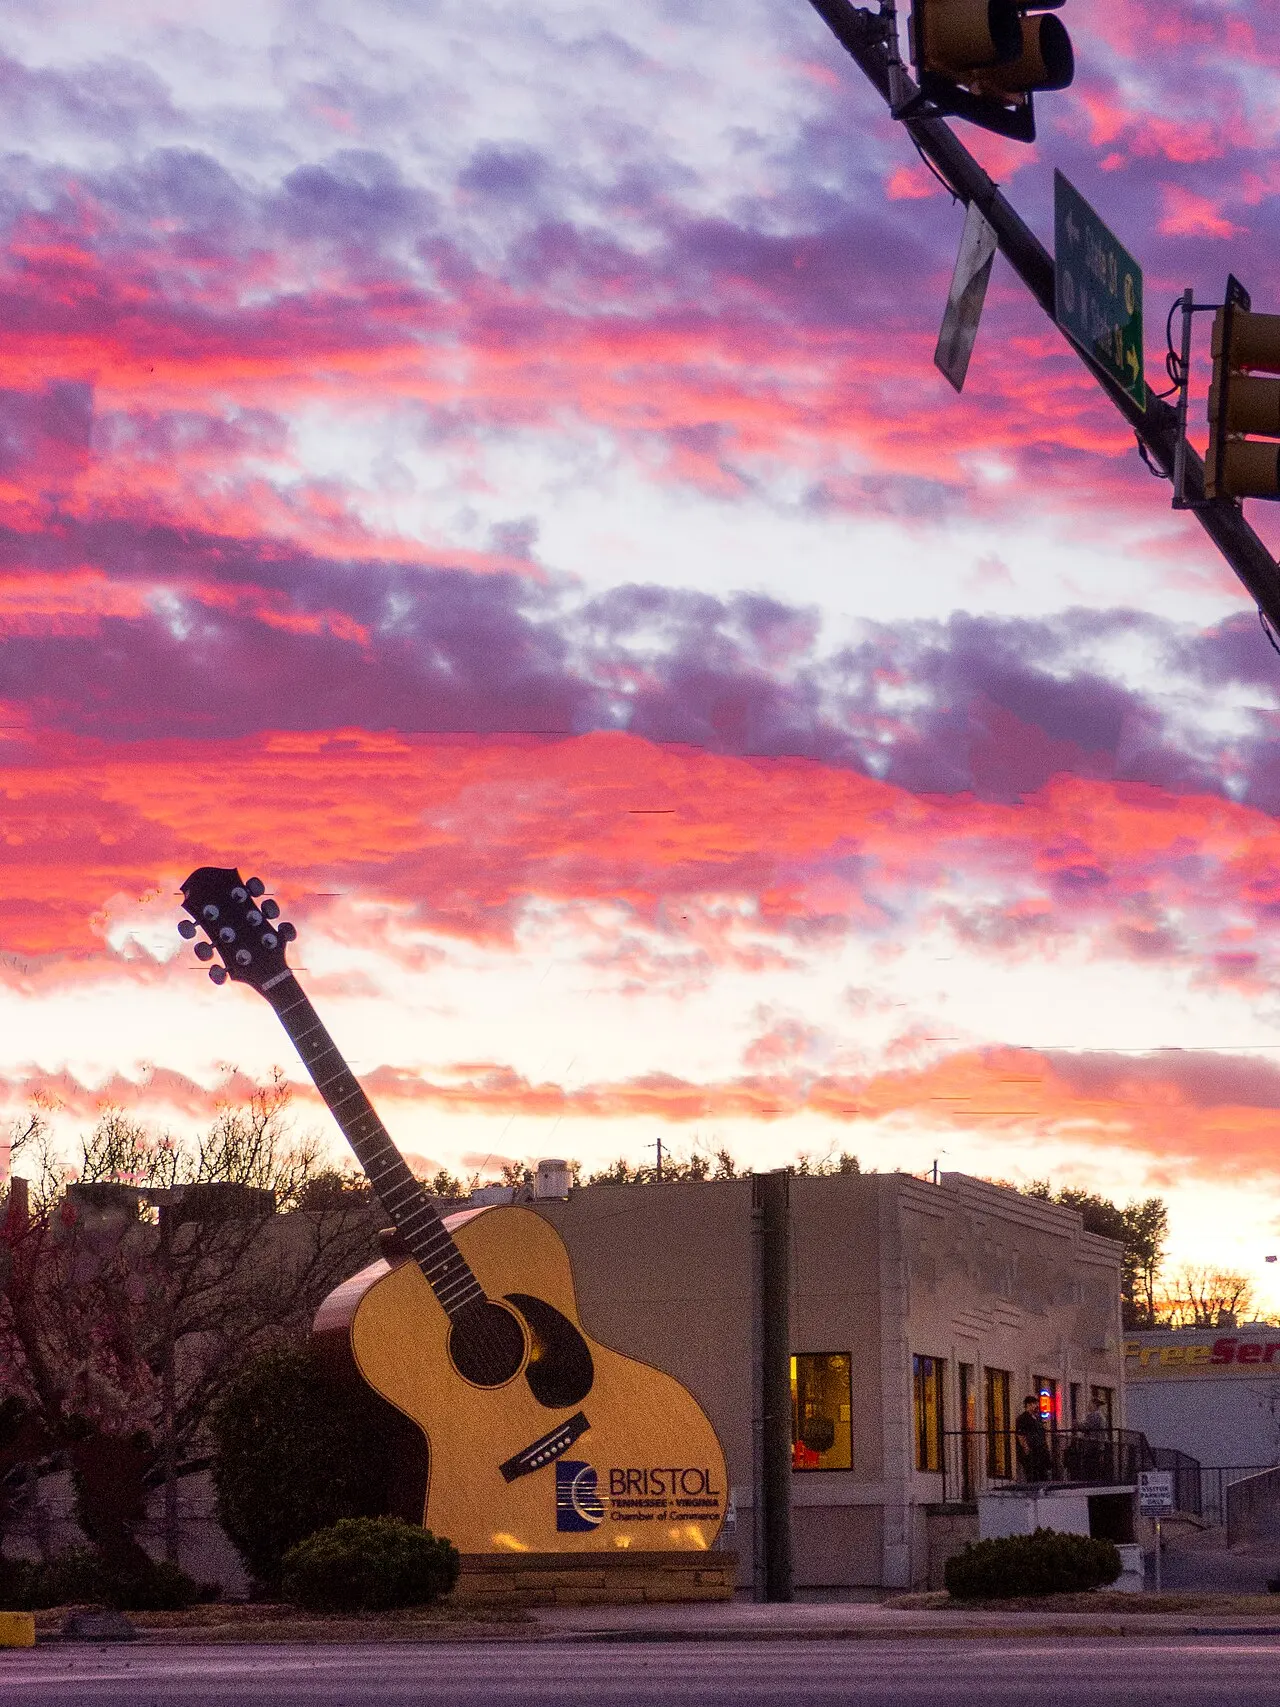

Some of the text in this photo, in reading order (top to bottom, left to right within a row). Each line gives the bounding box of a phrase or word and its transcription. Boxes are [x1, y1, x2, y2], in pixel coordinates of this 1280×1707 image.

[610, 1468, 720, 1496] BRISTOL
[611, 1498, 719, 1508] TENNESSEE VIRGINIA
[611, 1510, 720, 1521] Chamber of Commerce
